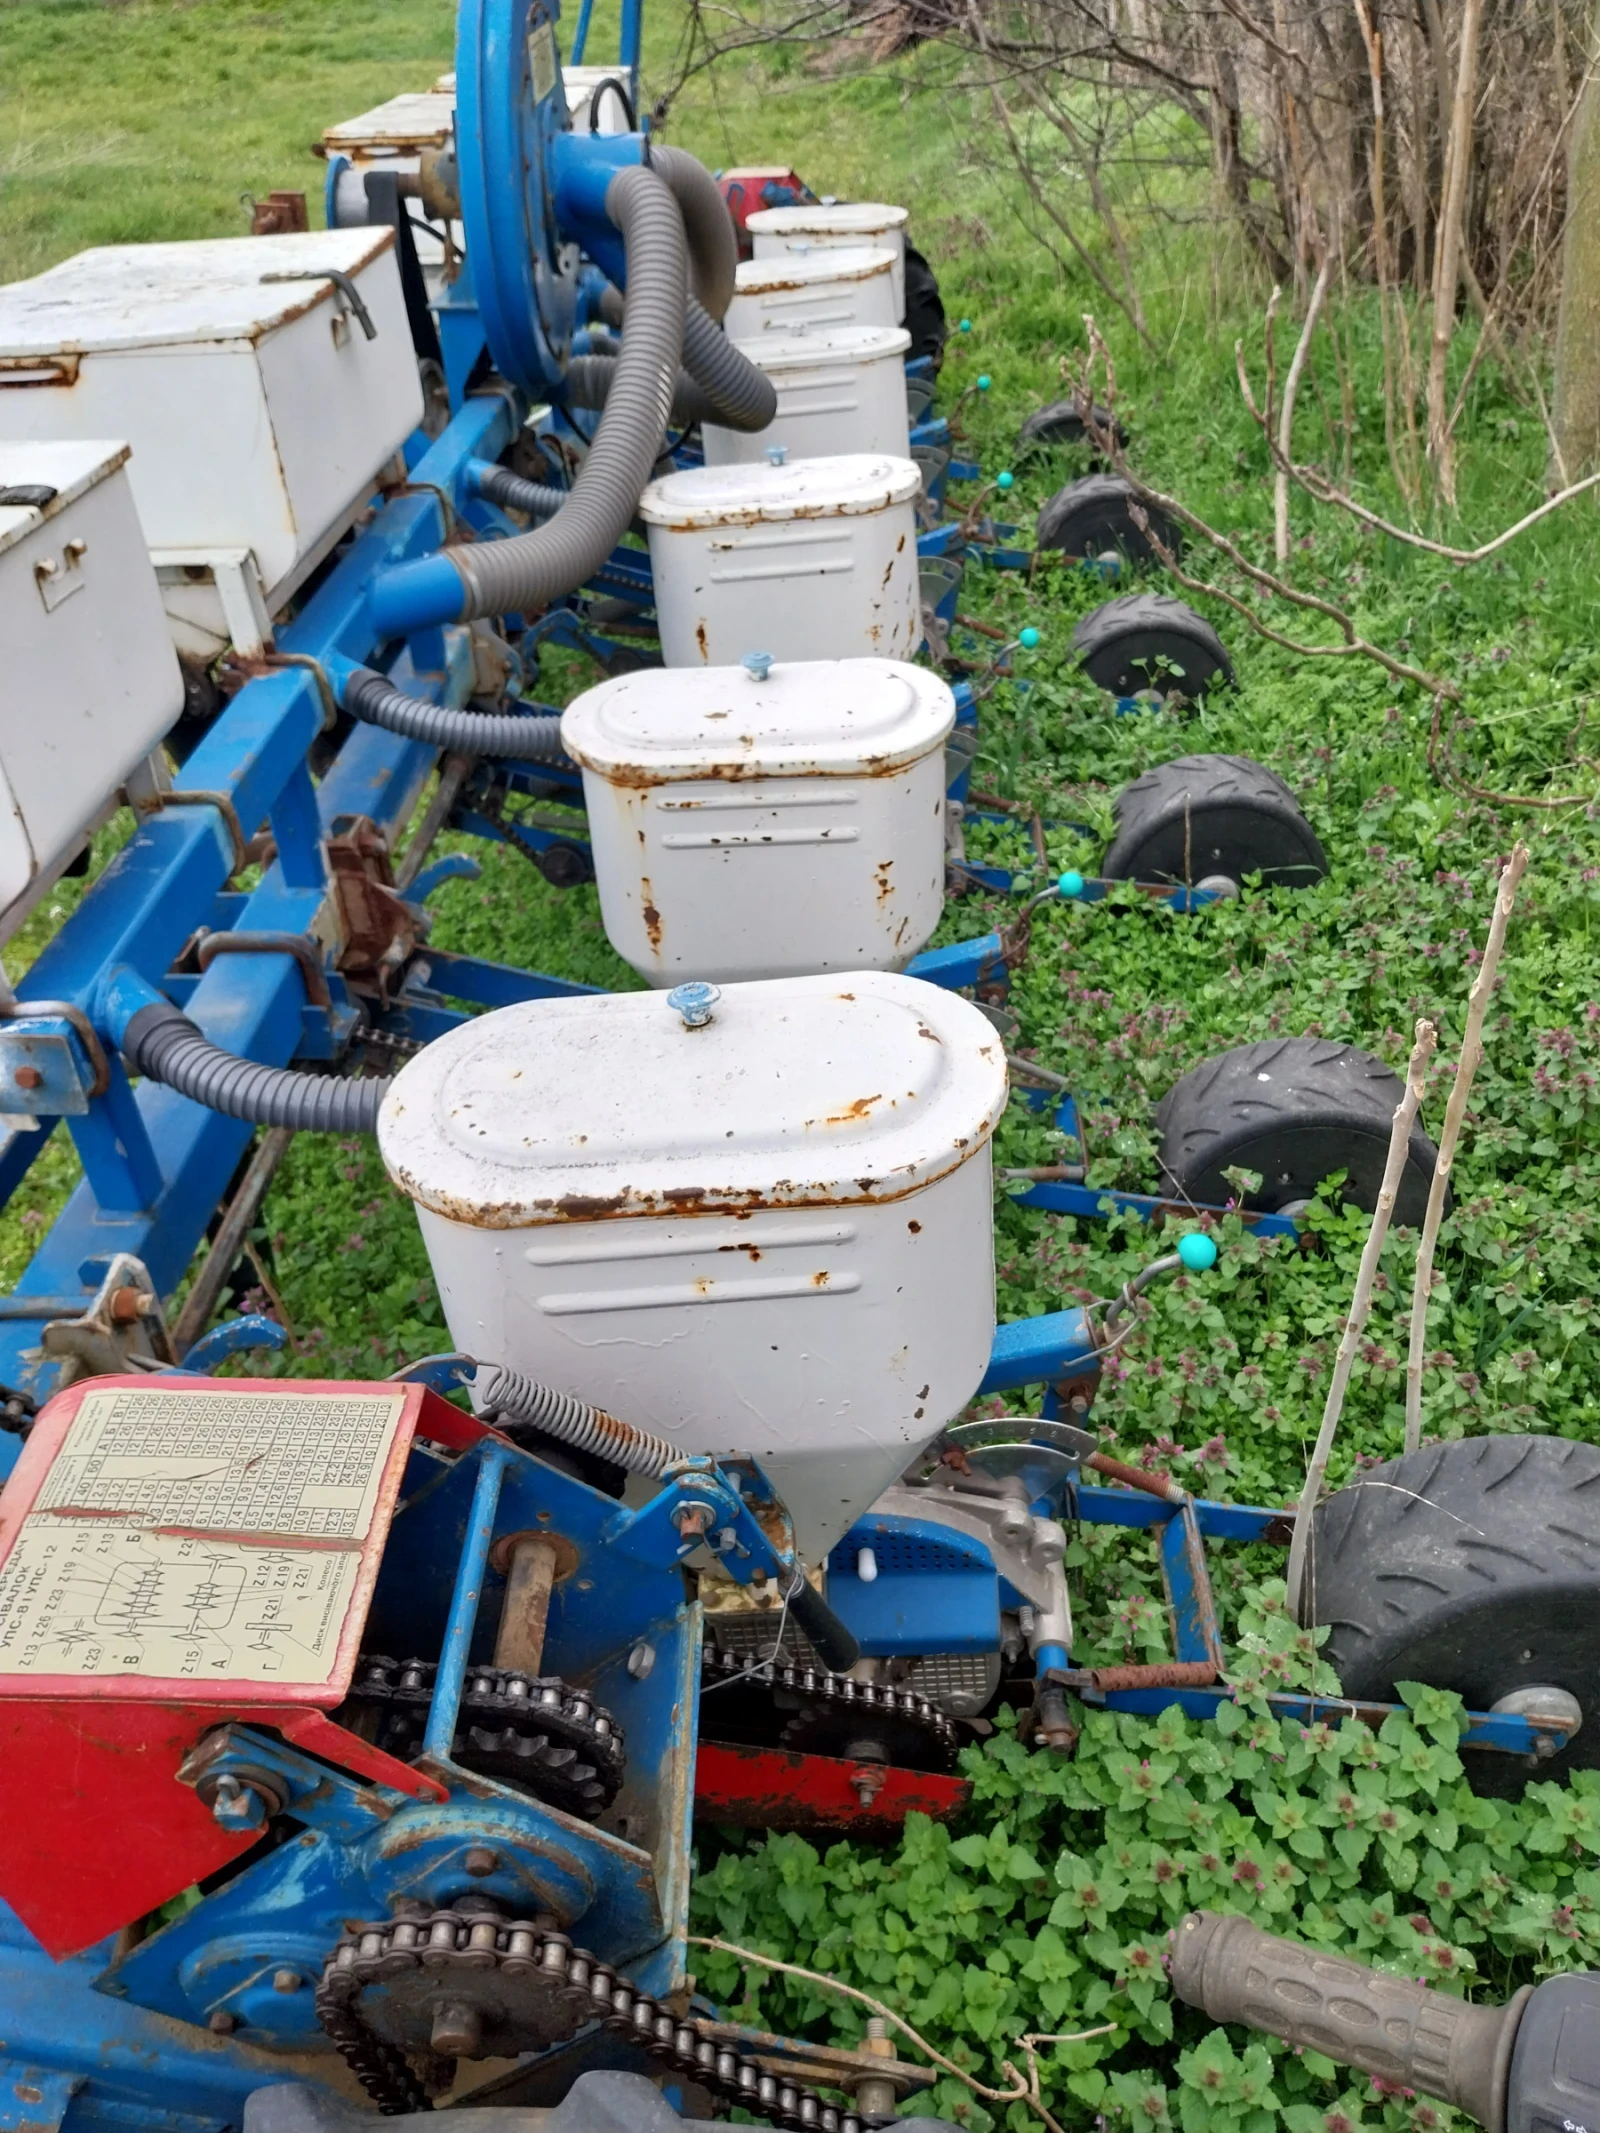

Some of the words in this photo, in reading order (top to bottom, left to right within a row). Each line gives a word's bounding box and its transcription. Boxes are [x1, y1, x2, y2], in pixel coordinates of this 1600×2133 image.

[163, 1398, 176, 1406] 26
[178, 1398, 190, 1407] 26
[194, 1399, 206, 1408] 26
[225, 1400, 238, 1409] 26
[240, 1400, 252, 1410] 26
[256, 1400, 268, 1410] 26
[272, 1401, 284, 1410] 26
[287, 1402, 299, 1412] 26
[303, 1402, 315, 1412] 26
[318, 1403, 330, 1413] 26
[334, 1404, 346, 1414] 26
[350, 1404, 360, 1412] 13
[365, 1404, 376, 1413] 13
[380, 1405, 391, 1414] 13
[158, 1412, 170, 1420] 13
[173, 1412, 185, 1420] 13
[189, 1412, 200, 1422] 23
[219, 1412, 232, 1422] 23
[235, 1414, 247, 1423] 23
[250, 1414, 262, 1424] 23
[266, 1414, 278, 1424] 23
[282, 1416, 294, 1426] 23
[298, 1416, 310, 1426] 23
[313, 1417, 325, 1426] 23
[328, 1418, 340, 1428] 23
[344, 1418, 356, 1428] 23
[360, 1418, 371, 1428] 23
[375, 1419, 386, 1428] 23
[151, 1426, 163, 1436] 26
[166, 1428, 178, 1437] 23
[182, 1427, 194, 1436] 19
[213, 1428, 226, 1438] 23
[229, 1429, 241, 1439] 23
[246, 1430, 257, 1439] 19
[261, 1430, 272, 1439] 19
[278, 1430, 289, 1440] 15
[309, 1432, 320, 1440] 13
[293, 1432, 304, 1441] 15
[324, 1432, 336, 1442] 13
[339, 1433, 351, 1443] 23
[354, 1434, 366, 1444] 23
[370, 1434, 382, 1444] 19
[92, 1483, 108, 1497] 2,3
[112, 1443, 124, 1452] 12
[119, 1426, 132, 1436] 26
[127, 1411, 139, 1419] 13
[133, 1397, 145, 1406] 26
[108, 1483, 124, 1497] 3,2
[128, 1443, 140, 1452] 12
[136, 1426, 148, 1436] 19
[142, 1411, 154, 1420] 13
[148, 1397, 160, 1406] 26
[143, 1444, 155, 1454] 21
[159, 1444, 171, 1454] 21
[175, 1444, 187, 1454] 12
[207, 1445, 218, 1454] 19
[222, 1446, 234, 1456] 21
[238, 1446, 250, 1456] 19
[254, 1447, 266, 1457] 21
[272, 1448, 282, 1457] 19
[286, 1448, 298, 1458] 21
[302, 1448, 314, 1458] 19
[318, 1450, 330, 1460] 21
[334, 1450, 346, 1460] 19
[349, 1451, 361, 1460] 21
[365, 1450, 376, 1460] 19
[164, 1508, 178, 1524] 4,9
[172, 1485, 188, 1500] 6,6
[191, 1445, 202, 1454] 19
[198, 1428, 210, 1438] 26
[204, 1412, 216, 1422] 23
[210, 1399, 222, 1408] 26
[263, 1462, 277, 1481] 17,1
[279, 1462, 293, 1482] 18,8
[295, 1462, 309, 1482] 19,7
[309, 1463, 324, 1482] 21,7
[324, 1464, 340, 1484] 22,2
[340, 1464, 355, 1484] 24,6
[356, 1464, 370, 1484] 26,9
[78, 1482, 91, 1496] 40
[87, 1460, 101, 1473] 60
[124, 1484, 138, 1498] 4,1
[141, 1484, 155, 1498] 4,6
[156, 1484, 170, 1499] 5,7
[190, 1486, 203, 1500] 7,4
[205, 1486, 220, 1500] 8,2
[221, 1486, 235, 1500] 9,0
[238, 1487, 252, 1502] 9,9
[254, 1485, 268, 1504] 11,4
[270, 1486, 284, 1504] 12,6
[286, 1486, 300, 1505] 13,1
[180, 1510, 194, 1524] 5,6
[196, 1510, 210, 1524] 6,1
[212, 1510, 226, 1525] 6,7
[228, 1511, 242, 1526] 7,4
[245, 1512, 259, 1526] 8,5
[262, 1512, 276, 1527] 9,4
[278, 1512, 292, 1528] 9,8
[294, 1510, 309, 1530] 10,9
[310, 1511, 324, 1531] 11,1
[326, 1511, 341, 1532] 12,3
[342, 1512, 356, 1532] 13,5
[0, 1540, 28, 1595] ЕРЕДАЧ
[317, 1559, 333, 1590] Колесо
[312, 1628, 325, 1651] Диск
